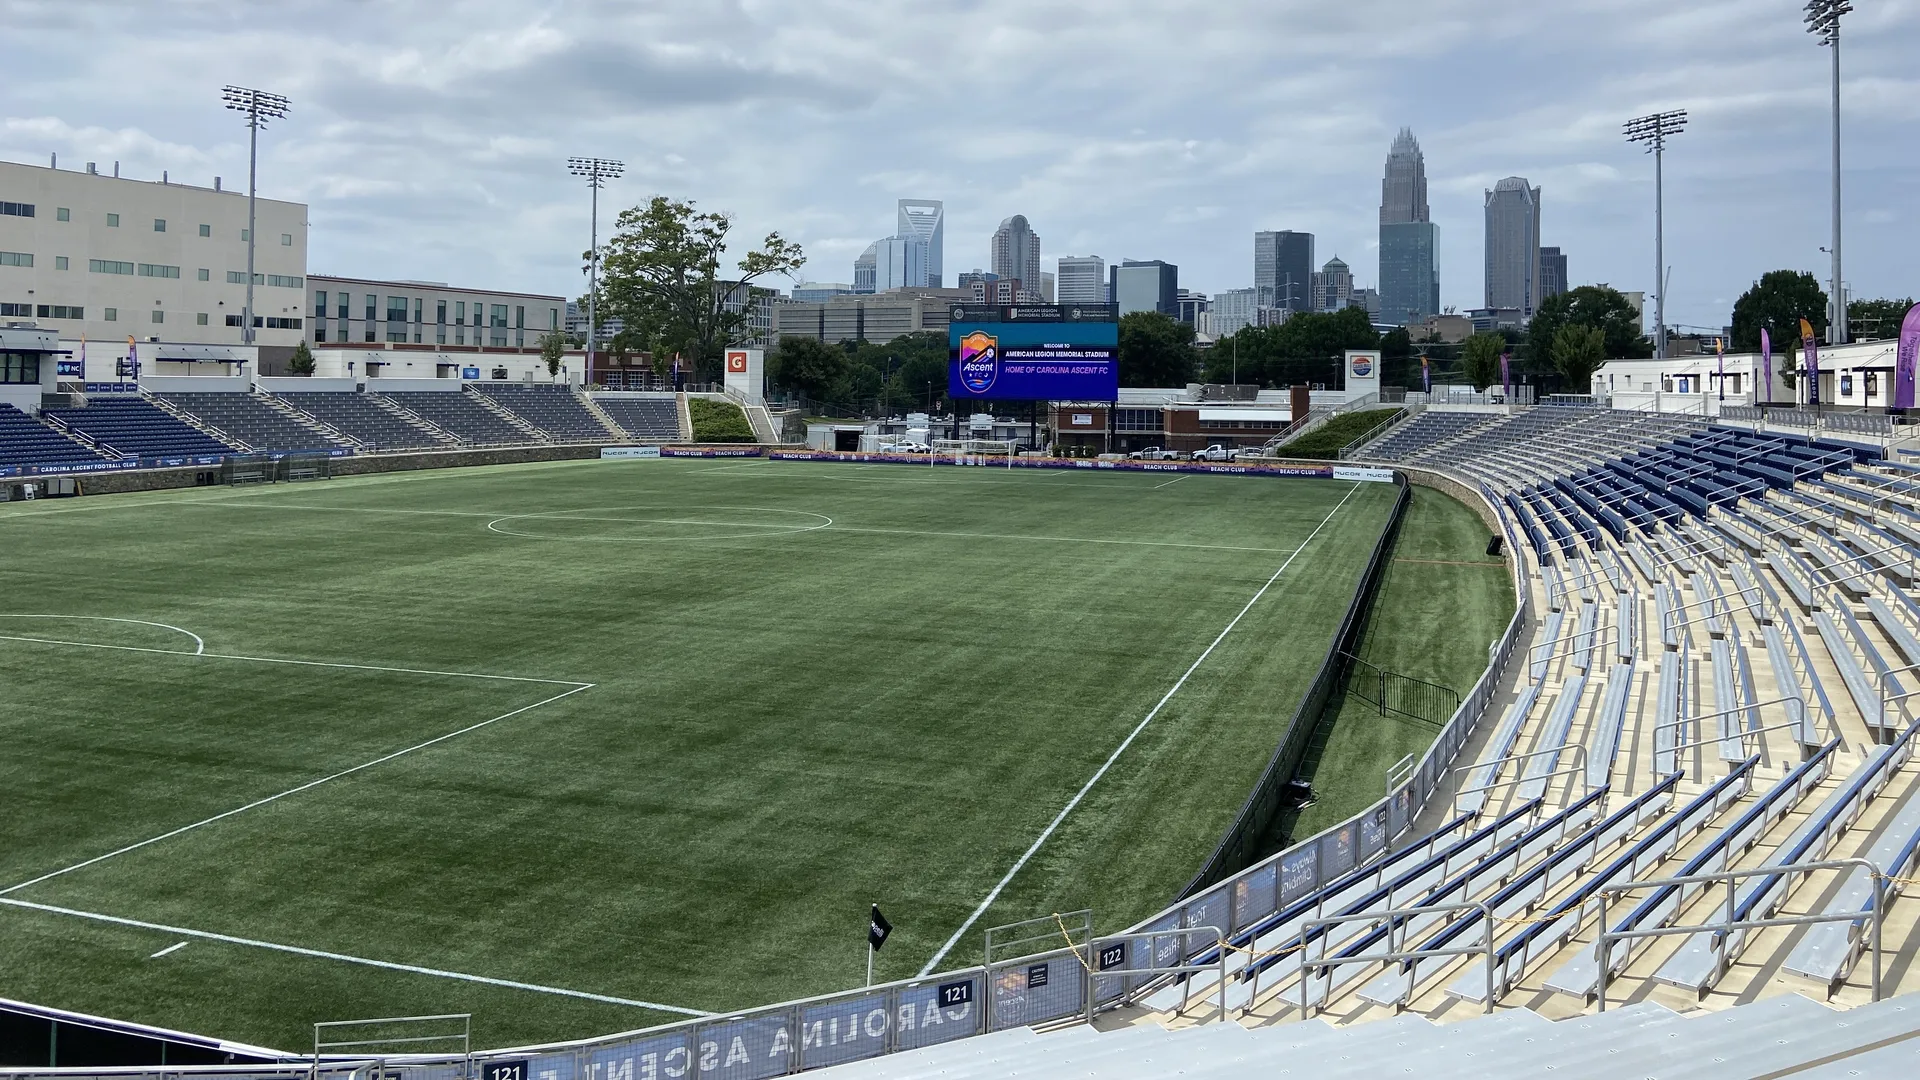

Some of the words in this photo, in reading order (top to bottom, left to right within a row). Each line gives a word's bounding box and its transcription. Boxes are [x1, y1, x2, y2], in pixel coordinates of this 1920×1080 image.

[1907, 336, 1917, 366] Together
[731, 356, 742, 369] G
[963, 362, 993, 372] Ascent
[1036, 366, 1070, 374] CAROLINA
[1071, 366, 1098, 374] ASCENT
[1099, 366, 1108, 374] FC
[1103, 948, 1122, 966] 122
[945, 985, 967, 1002] 121
[492, 1065, 520, 1080] 121
